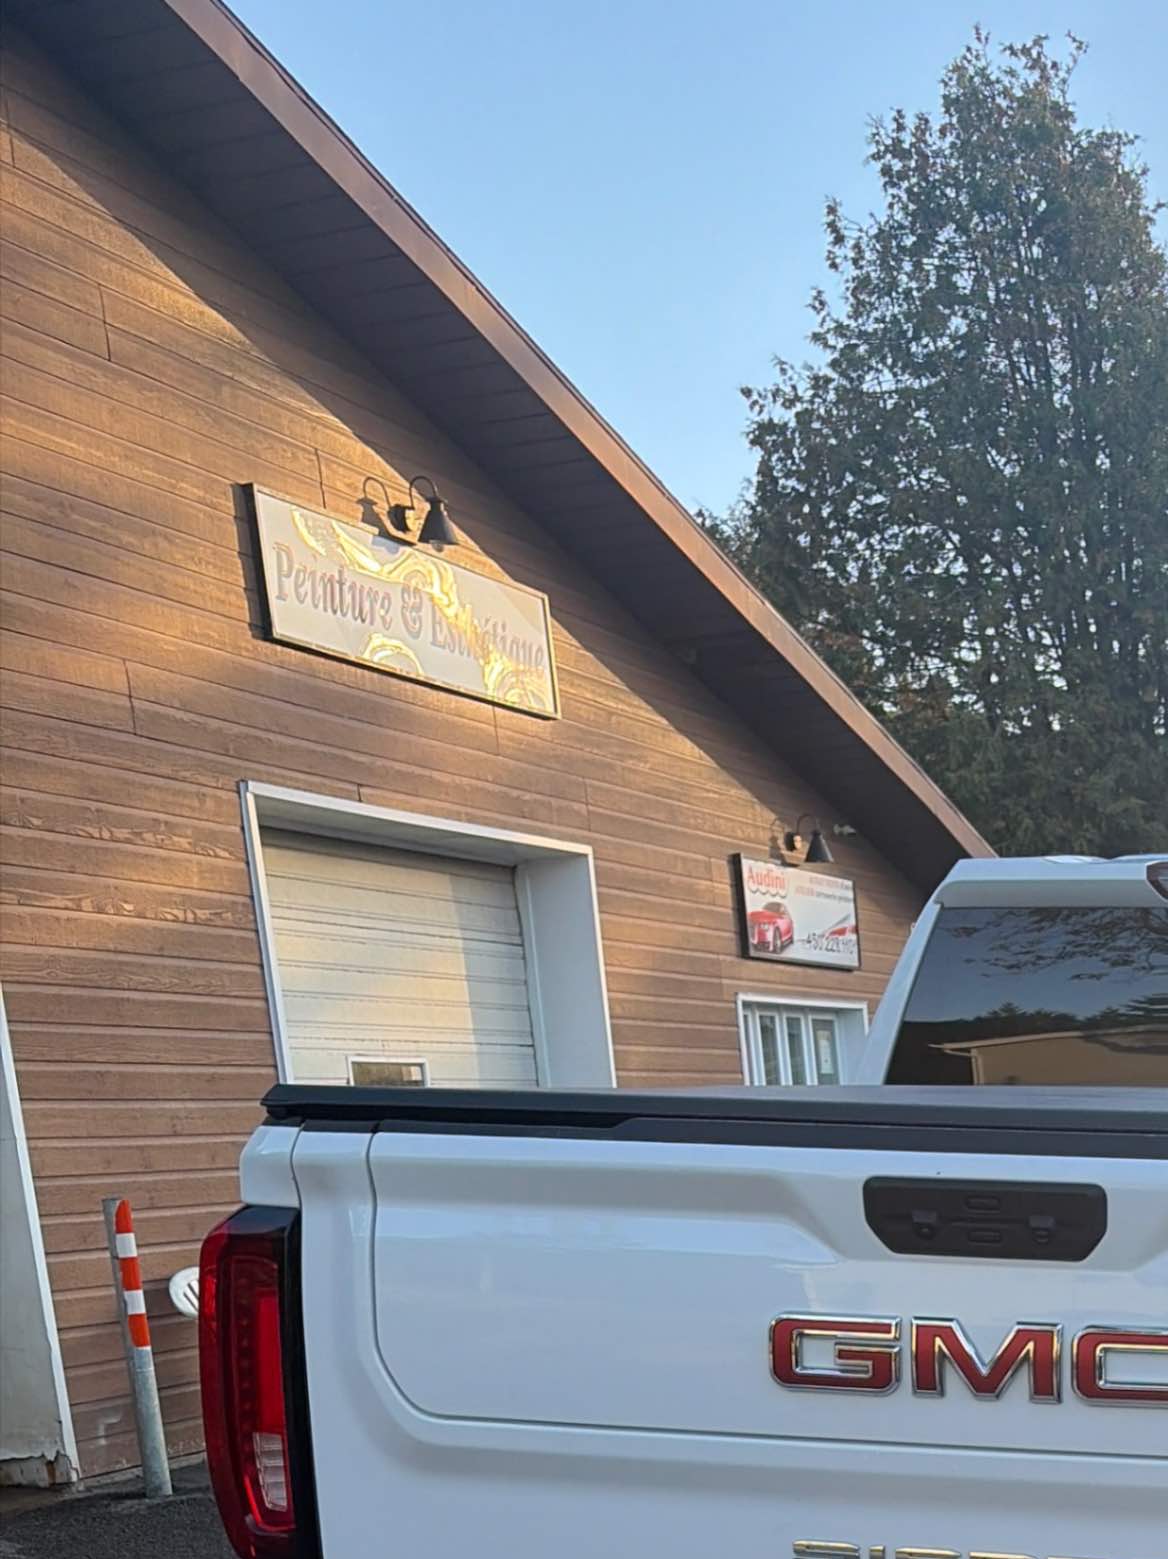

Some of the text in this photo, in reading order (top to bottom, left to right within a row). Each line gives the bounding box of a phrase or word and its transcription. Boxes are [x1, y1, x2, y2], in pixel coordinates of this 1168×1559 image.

[273, 542, 545, 668] Peinture & Estétique
